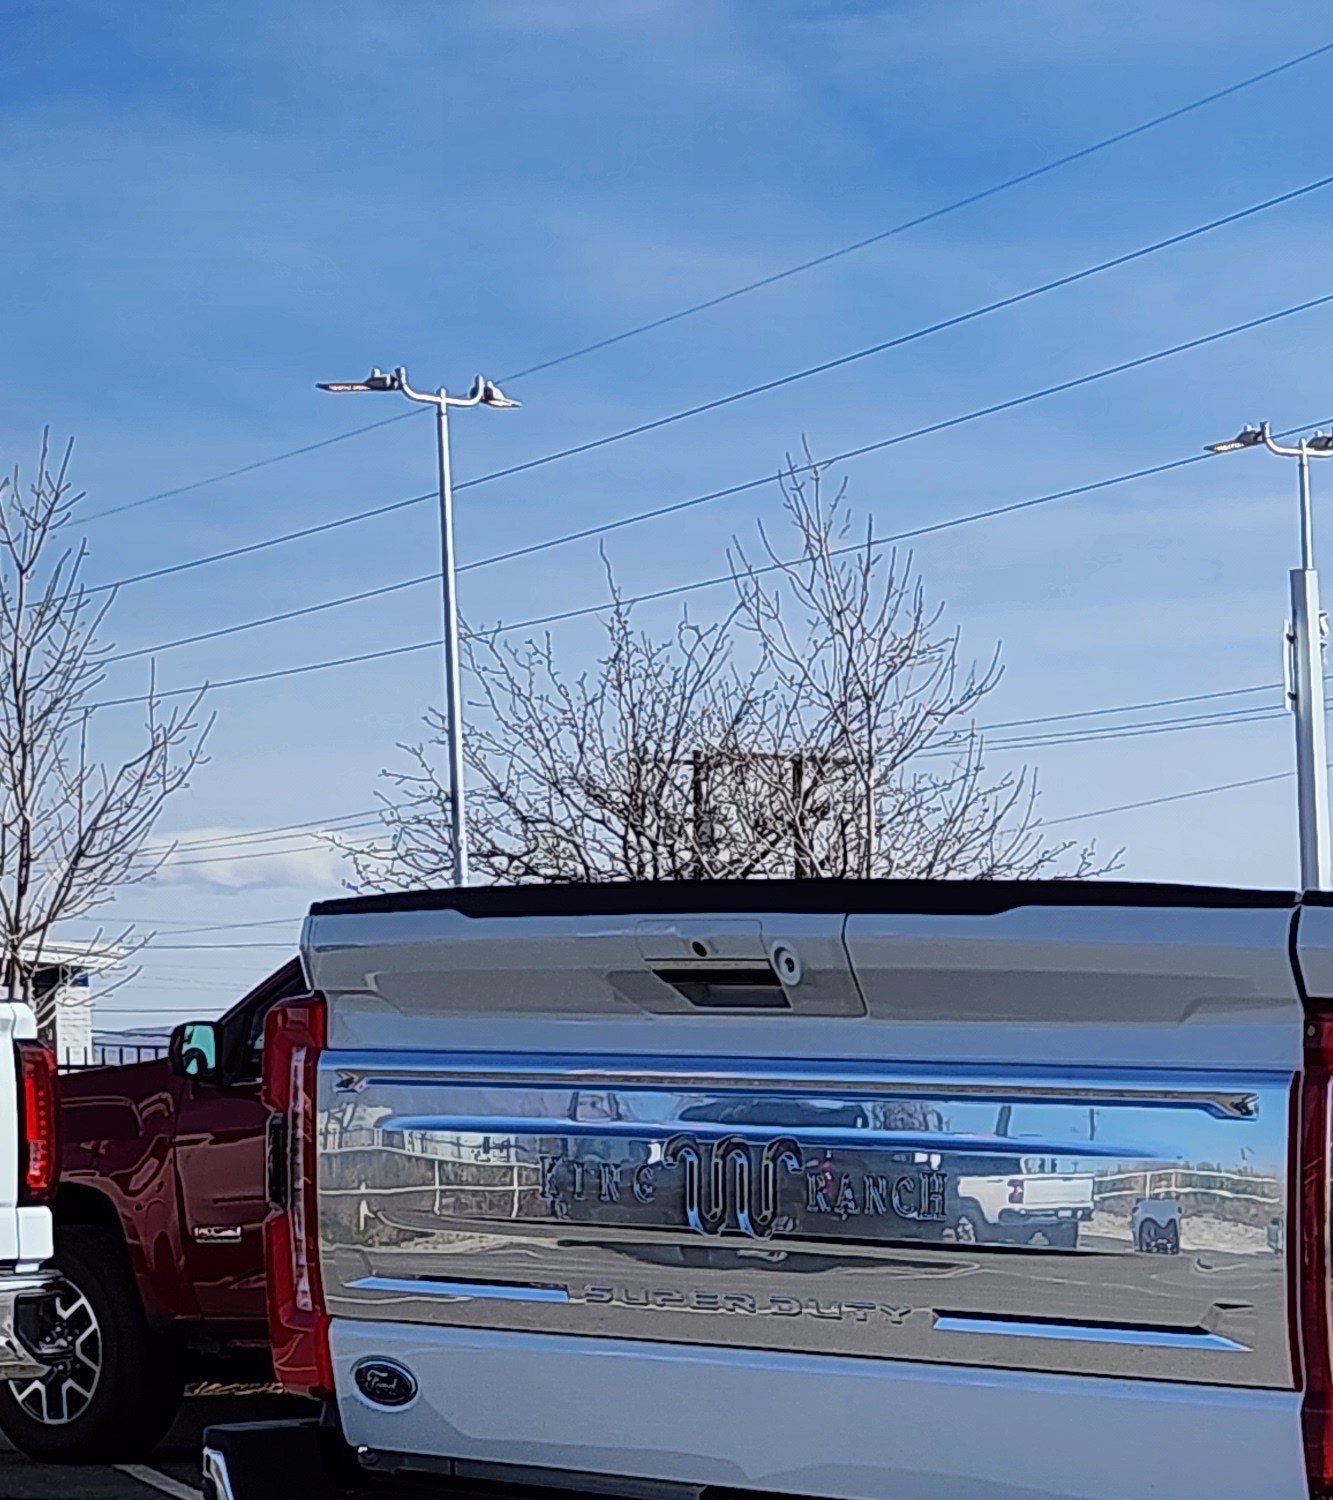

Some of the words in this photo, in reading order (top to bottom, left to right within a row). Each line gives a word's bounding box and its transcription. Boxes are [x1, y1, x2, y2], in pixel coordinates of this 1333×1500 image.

[538, 1153, 656, 1204] KING
[806, 1171, 949, 1223] RANCH
[584, 1283, 757, 1315] SUPER
[768, 1294, 913, 1326] DUTY
